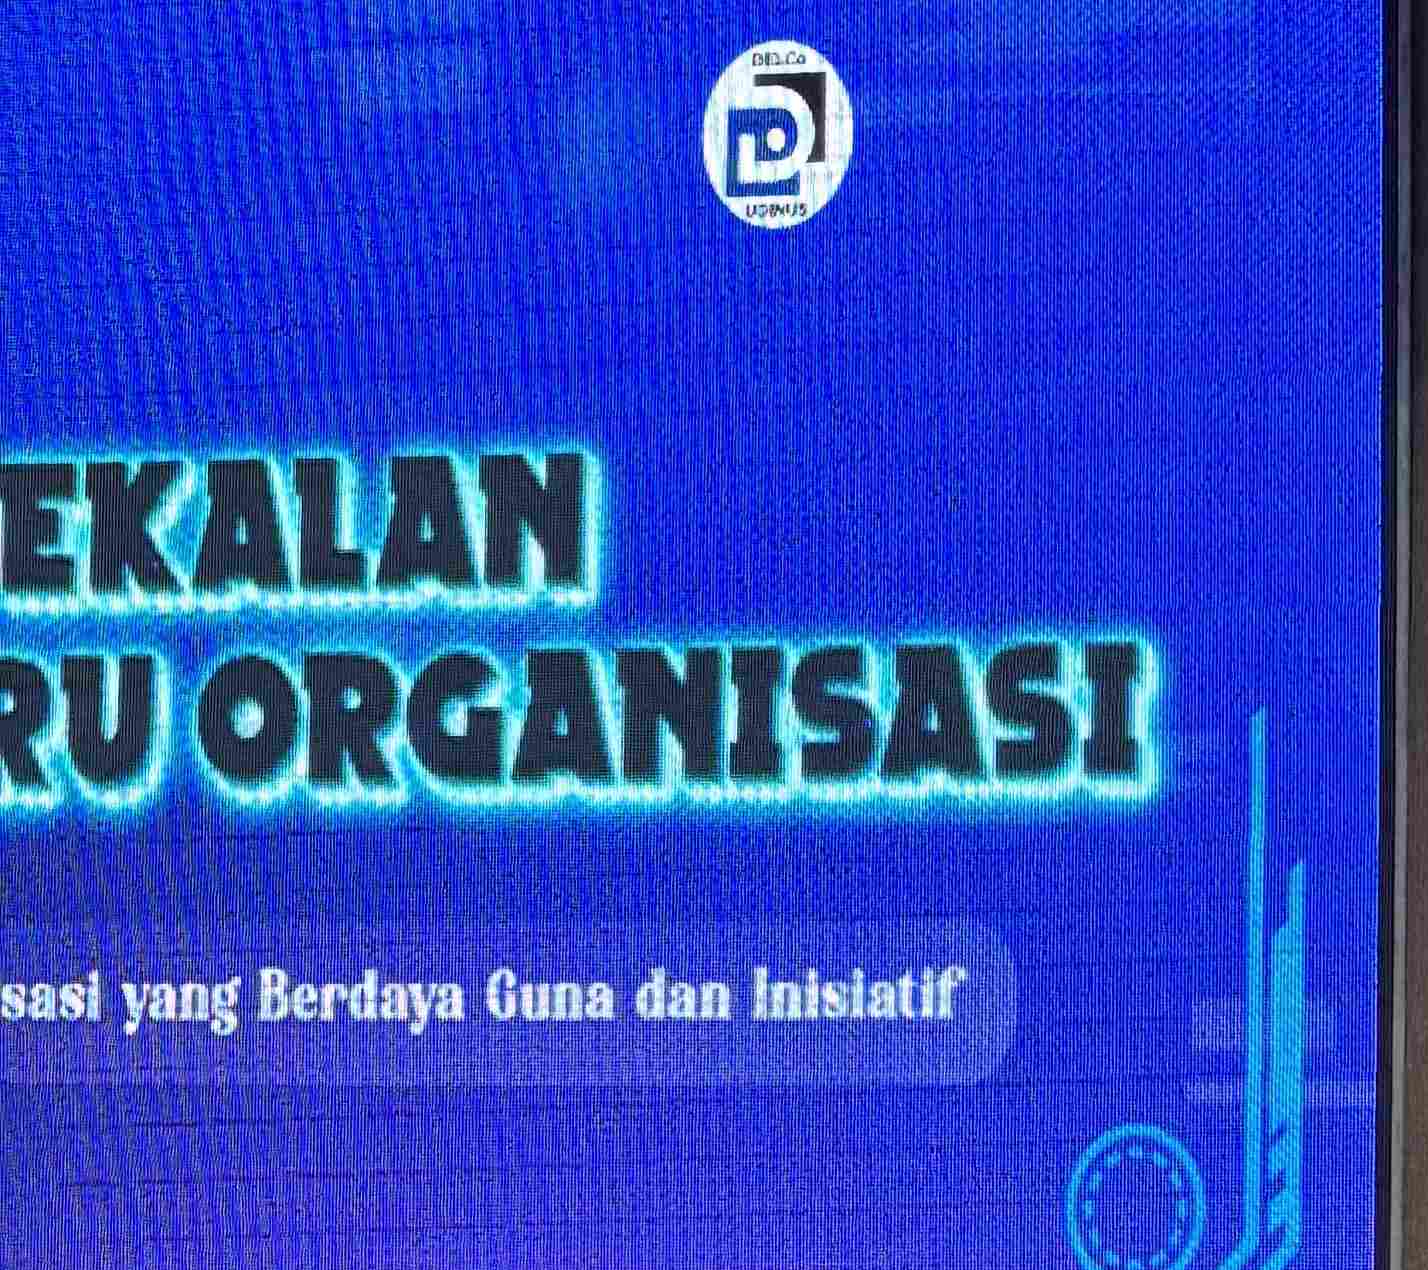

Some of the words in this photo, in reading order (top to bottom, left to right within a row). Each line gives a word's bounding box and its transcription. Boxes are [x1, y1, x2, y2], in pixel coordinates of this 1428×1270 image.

[0, 450, 588, 596] EKALAN
[0, 651, 158, 787] RU
[197, 640, 1142, 784] ORGANISASI
[0, 968, 101, 1023] sasi
[121, 975, 242, 1036] yang
[258, 966, 466, 1036] Berdaya
[486, 967, 614, 1022] Guna
[636, 966, 731, 1022] dan
[751, 965, 968, 1022] Inisiatif
